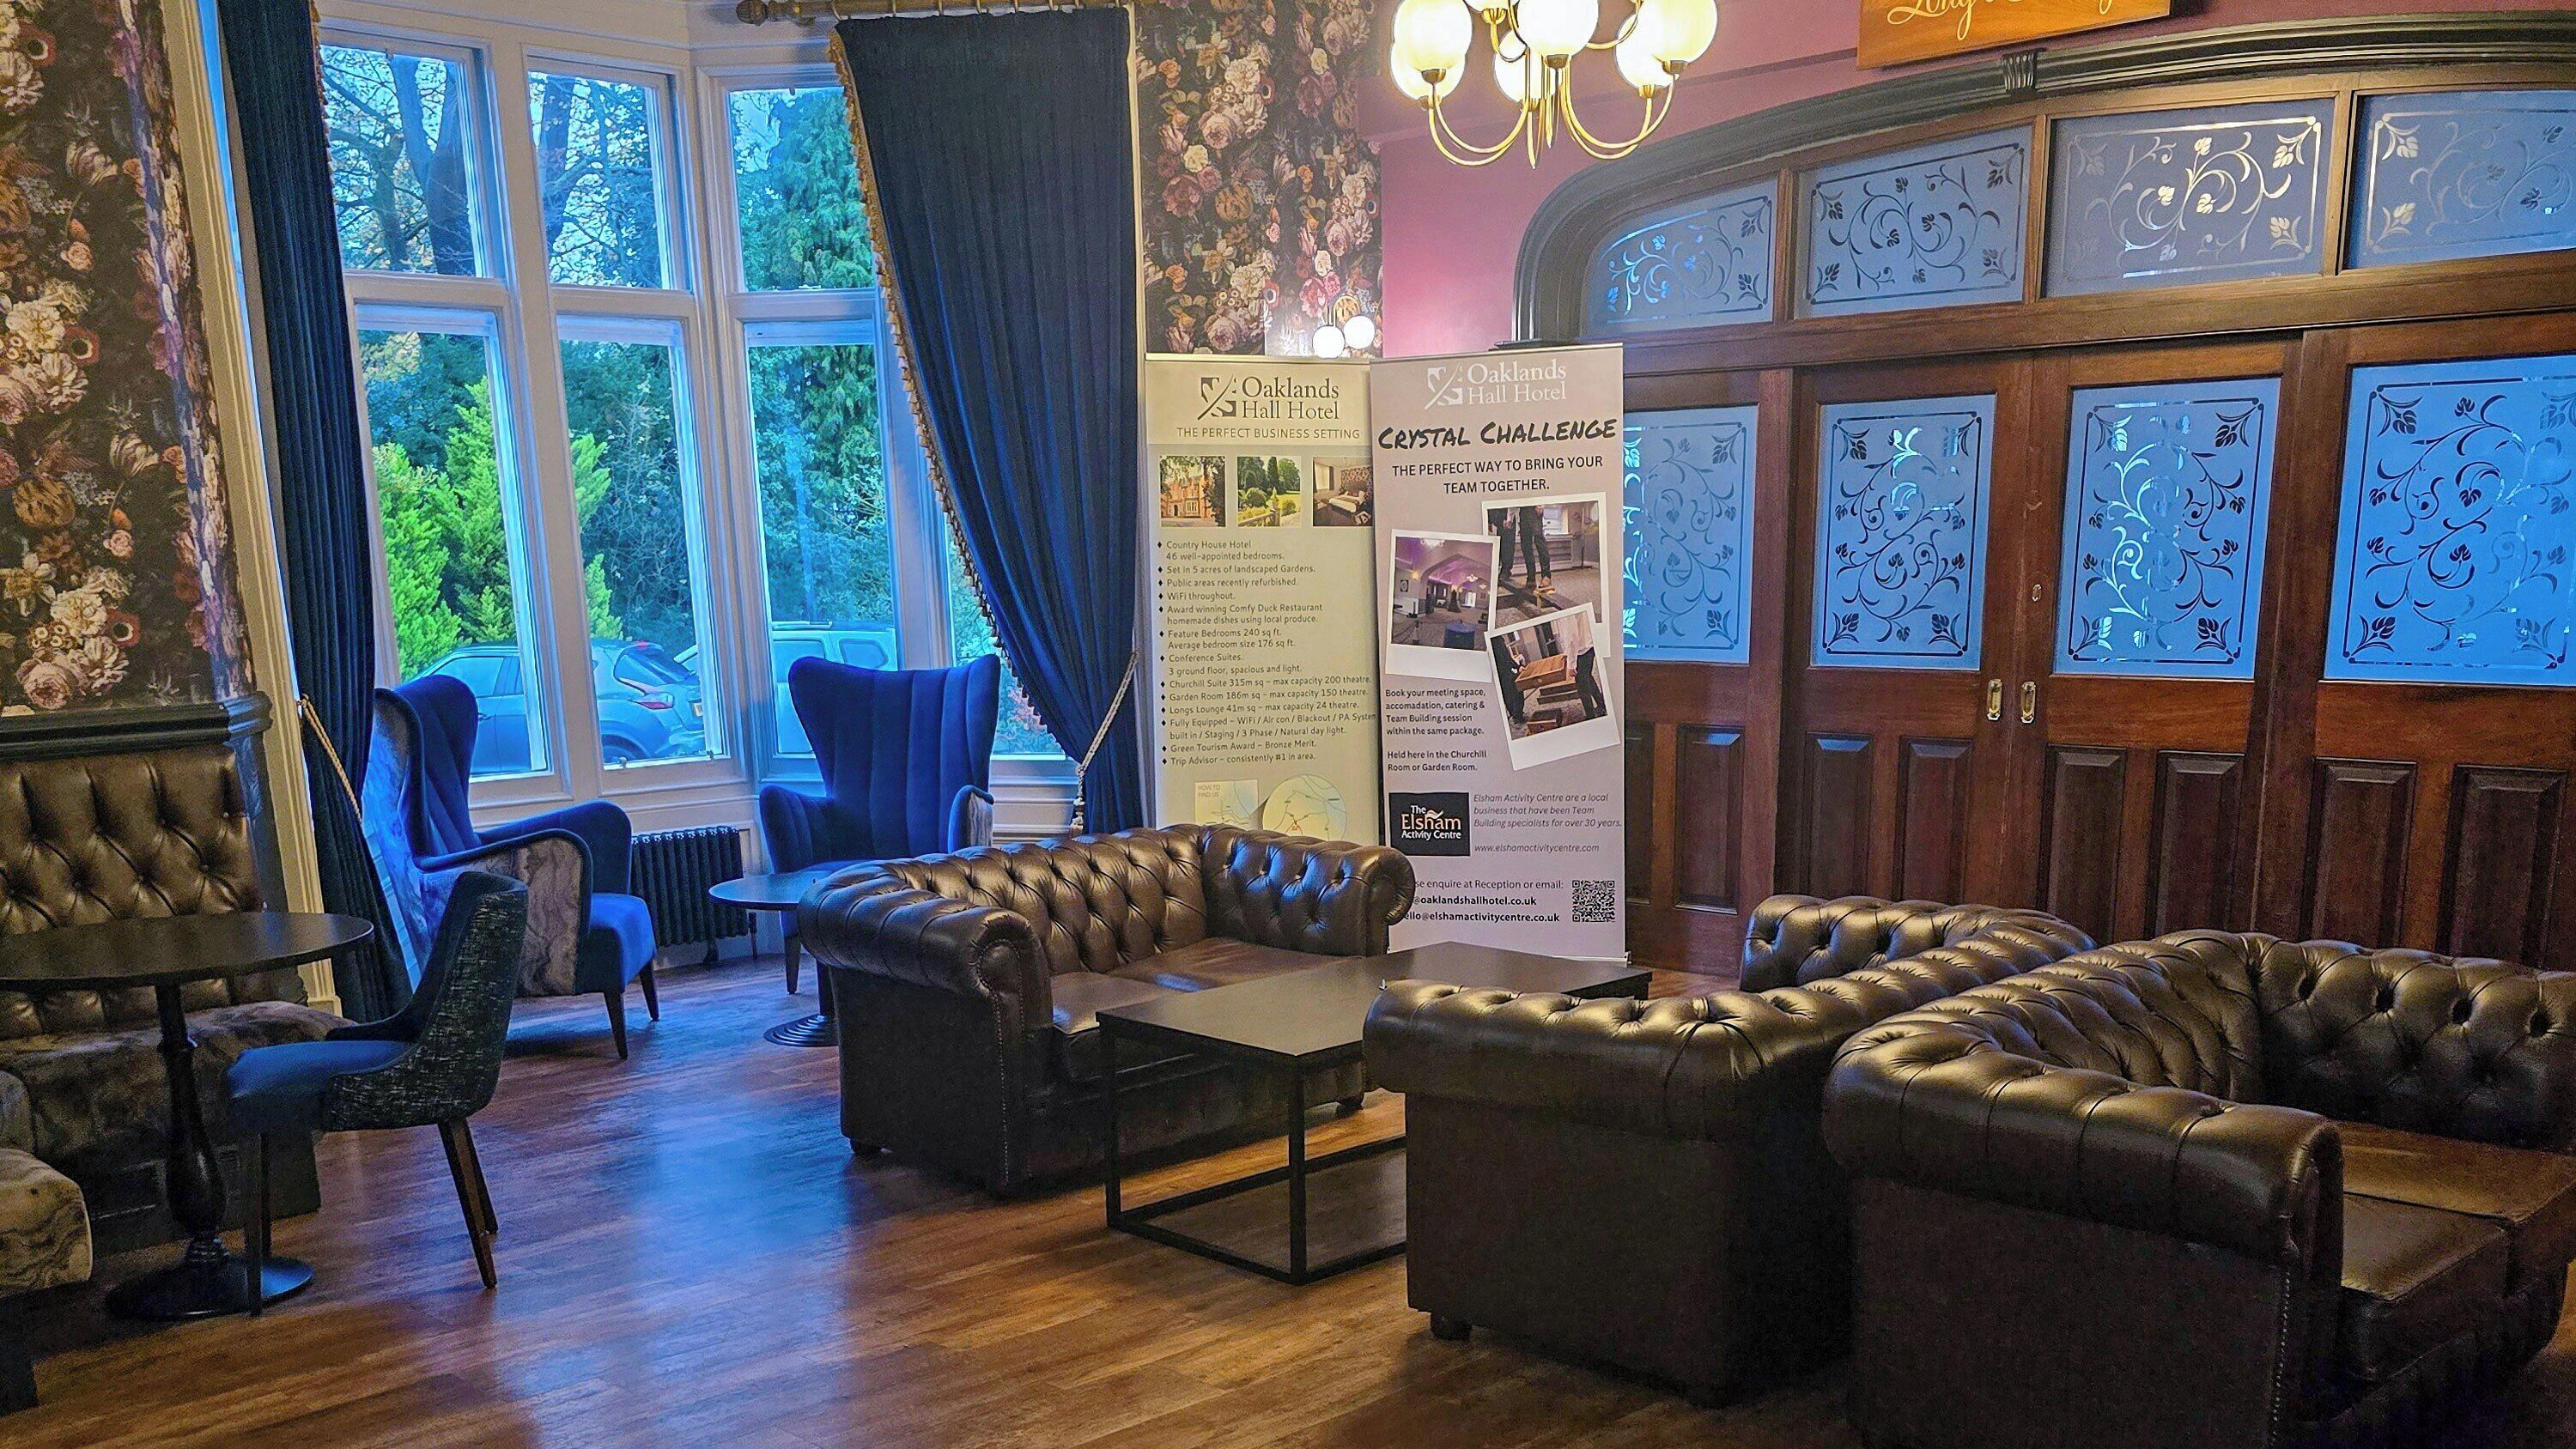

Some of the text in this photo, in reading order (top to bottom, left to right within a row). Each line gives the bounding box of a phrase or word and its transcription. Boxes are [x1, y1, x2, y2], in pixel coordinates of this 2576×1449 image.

[1467, 359, 1566, 384] Oaklands
[1242, 376, 1339, 398] Oaklands
[1468, 381, 1566, 405] Hall Hotel
[1242, 401, 1339, 420] Hall Hotel
[1177, 427, 1360, 439] THE PERFECT BUSINESS SETTING
[1378, 419, 1617, 449] CRYSTAL CHALLENGE
[1393, 456, 1603, 476] THE PERFECT WAY TO BRING YOUR
[1444, 479, 1550, 494] TEAM TOGETHER.
[1167, 541, 1200, 550] Country
[1180, 553, 1241, 561] well-appointed
[1235, 566, 1278, 574] landscaped
[1167, 579, 1192, 587] Public
[1218, 579, 1249, 588] recently
[1188, 592, 1236, 602] throughout.
[1195, 606, 1227, 615] winning
[1230, 604, 1255, 614] Comfy
[1241, 616, 1261, 626] using
[1285, 615, 1317, 624] produce.
[1243, 628, 1260, 637] 240
[1168, 641, 1200, 651] Average
[1177, 667, 1205, 676] ground
[1207, 667, 1228, 676] floor,
[1230, 665, 1264, 675] spacious
[1283, 664, 1302, 674] light.
[1291, 676, 1322, 687] capacity
[1287, 689, 1318, 700] capacity
[1426, 688, 1458, 699] meeting
[1170, 706, 1194, 715] Longs
[1196, 705, 1224, 714] Lounge
[1283, 702, 1314, 712] capacity
[1386, 701, 1477, 711] accomadation, catering
[1170, 719, 1189, 728] Fully
[1192, 718, 1227, 727] Equipped
[1409, 714, 1442, 724] Building
[1205, 731, 1234, 741] Staging
[1310, 727, 1324, 737] day
[1327, 726, 1346, 735] light.
[1449, 727, 1484, 737] package.
[1170, 758, 1187, 767] Trip
[1227, 755, 1273, 764] consistently
[1504, 794, 1534, 803] Activity
[1411, 805, 1426, 814] The
[1401, 814, 1461, 829] Elsham
[1508, 819, 1549, 828] specialists
[1401, 830, 1461, 840] Activity Centre
[1474, 844, 1599, 853] www.elshamactivitycentre.com
[1427, 881, 1461, 889] enquire
[1475, 880, 1521, 890] Reception
[1535, 881, 1564, 889] email:
[1414, 896, 1536, 906] @oaklandshallhotel.co.uk
[1404, 912, 1559, 922] ello@elshamactivitycentre.co.uk
